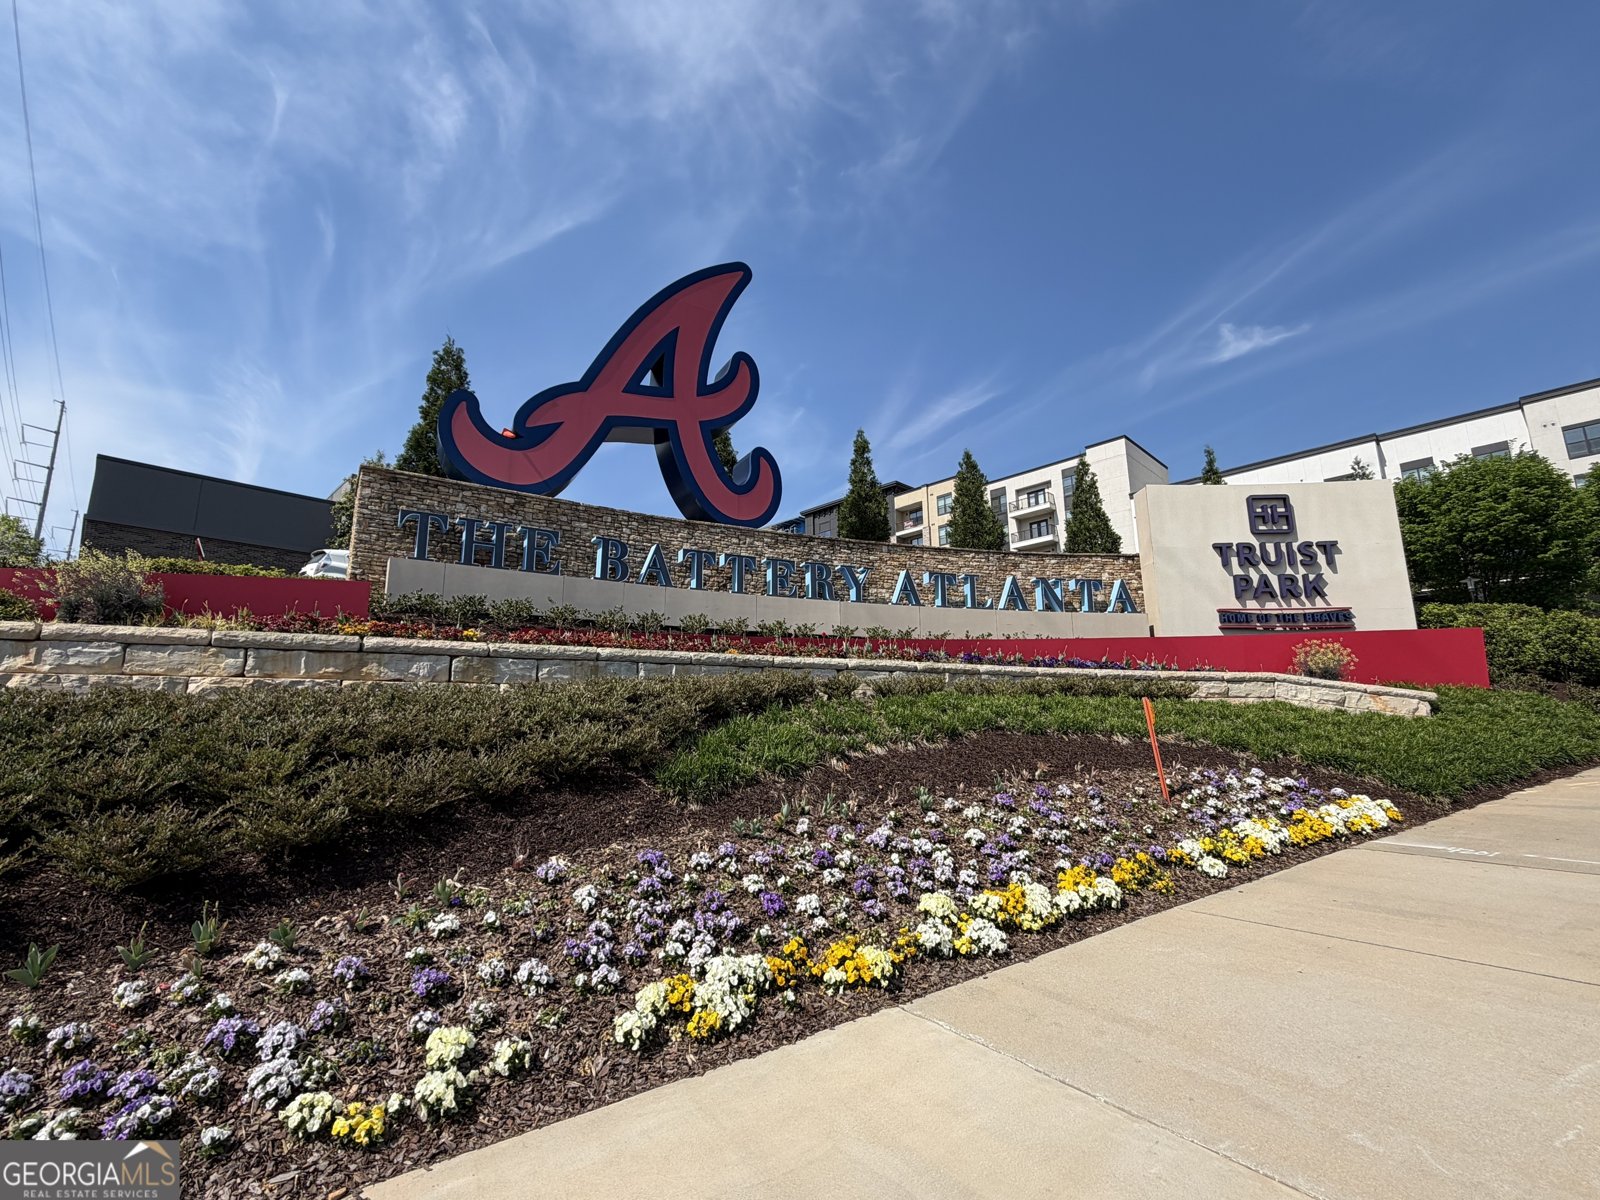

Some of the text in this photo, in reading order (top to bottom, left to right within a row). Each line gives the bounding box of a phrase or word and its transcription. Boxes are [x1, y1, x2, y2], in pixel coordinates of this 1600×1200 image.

[437, 261, 782, 529] A
[398, 509, 1141, 614] THE BATTERY ATLANTA
[1212, 540, 1339, 567] TRUIST
[1233, 573, 1328, 600] PARK
[1220, 610, 1355, 624] HOME OF THE BRAVES
